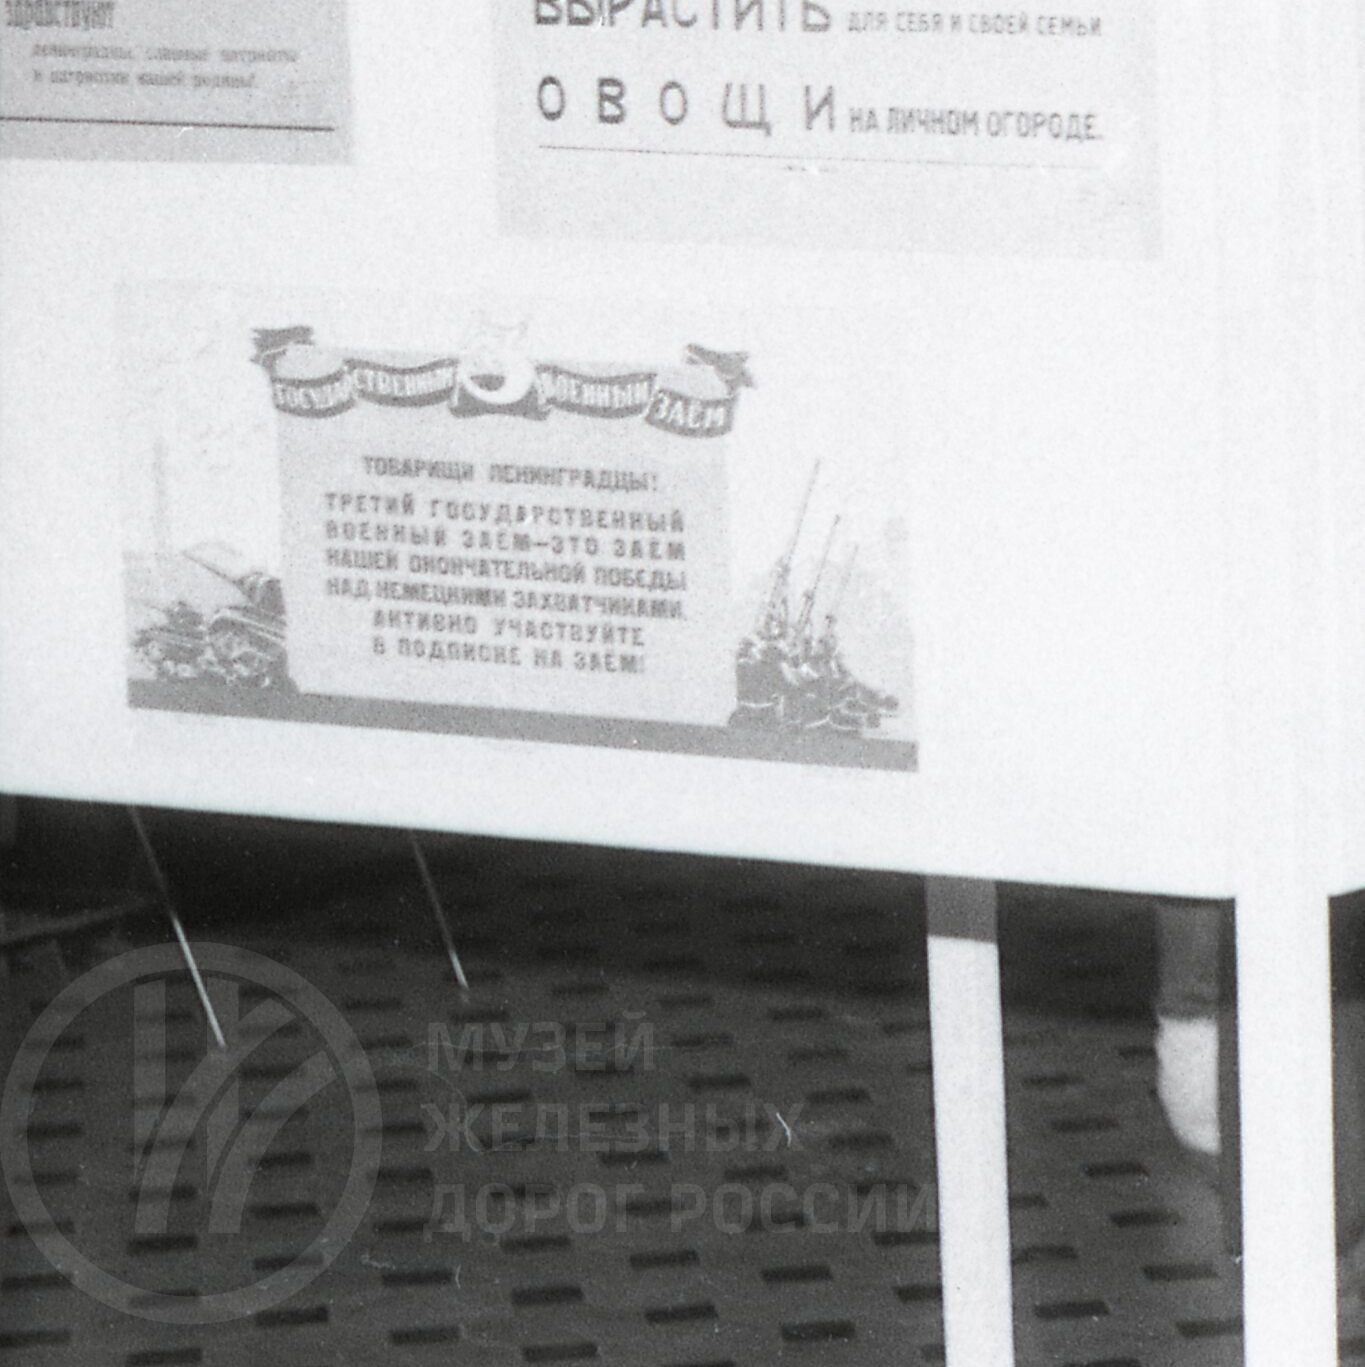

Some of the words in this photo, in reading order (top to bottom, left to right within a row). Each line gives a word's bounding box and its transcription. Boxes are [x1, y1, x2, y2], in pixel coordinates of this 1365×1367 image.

[848, 12, 888, 34] ДЛЯ
[896, 12, 944, 34] СЕБЯ
[951, 13, 962, 32] И
[969, 10, 1029, 35] СВОЕЙ
[1037, 15, 1102, 37] СЕМЬИ
[536, 75, 835, 137] ОВОЩИ
[850, 107, 879, 132] НА
[886, 107, 979, 135] ЛИЧНОМ
[363, 455, 474, 484] ТОВАРИЩИ
[325, 491, 415, 517] ТРЕТИЙ
[430, 498, 685, 533] ГОСУДАРСТВЕННЫЙ
[326, 521, 446, 547] ВОЕННЫЙ
[326, 548, 399, 572] НАШЕЙ
[410, 552, 586, 584] ОКОНЧАТЕЛЬНОЙ
[595, 564, 687, 592] ПОБЕДЫ
[326, 576, 371, 602] НАД
[372, 607, 477, 635] АКТИВНО
[494, 616, 645, 647] УЧАСТВУЙТЕ
[372, 635, 386, 655] В
[398, 637, 521, 667] ПОДПИСКЕ
[534, 646, 562, 668] НА
